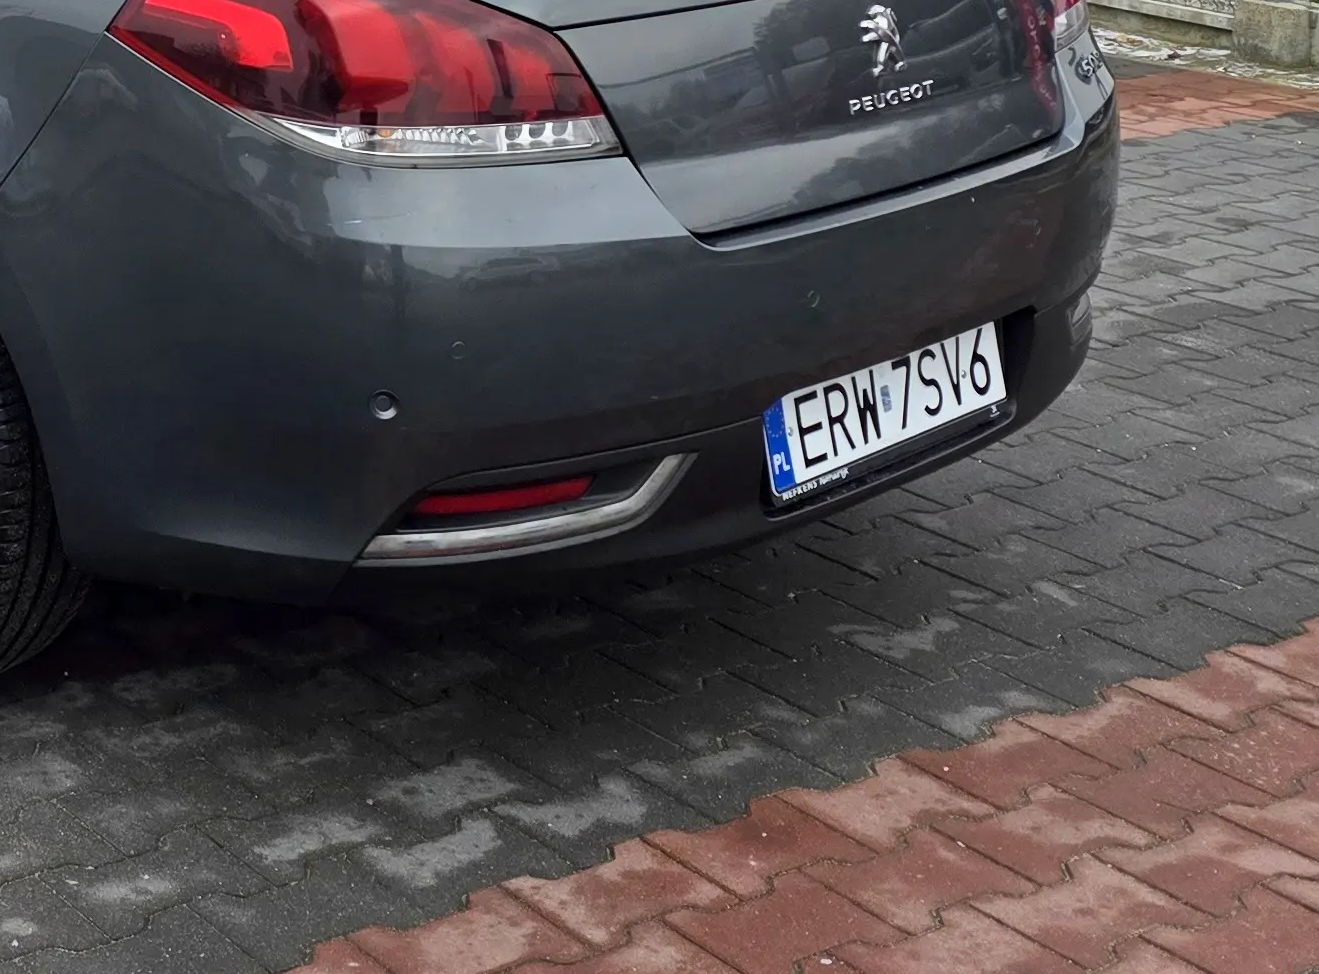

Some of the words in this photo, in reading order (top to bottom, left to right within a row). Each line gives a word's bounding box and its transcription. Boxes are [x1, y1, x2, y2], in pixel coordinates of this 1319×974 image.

[848, 79, 935, 116] PEUGEOT
[793, 369, 883, 469] ERW
[891, 327, 992, 430] 7SV6
[772, 451, 791, 476] PL
